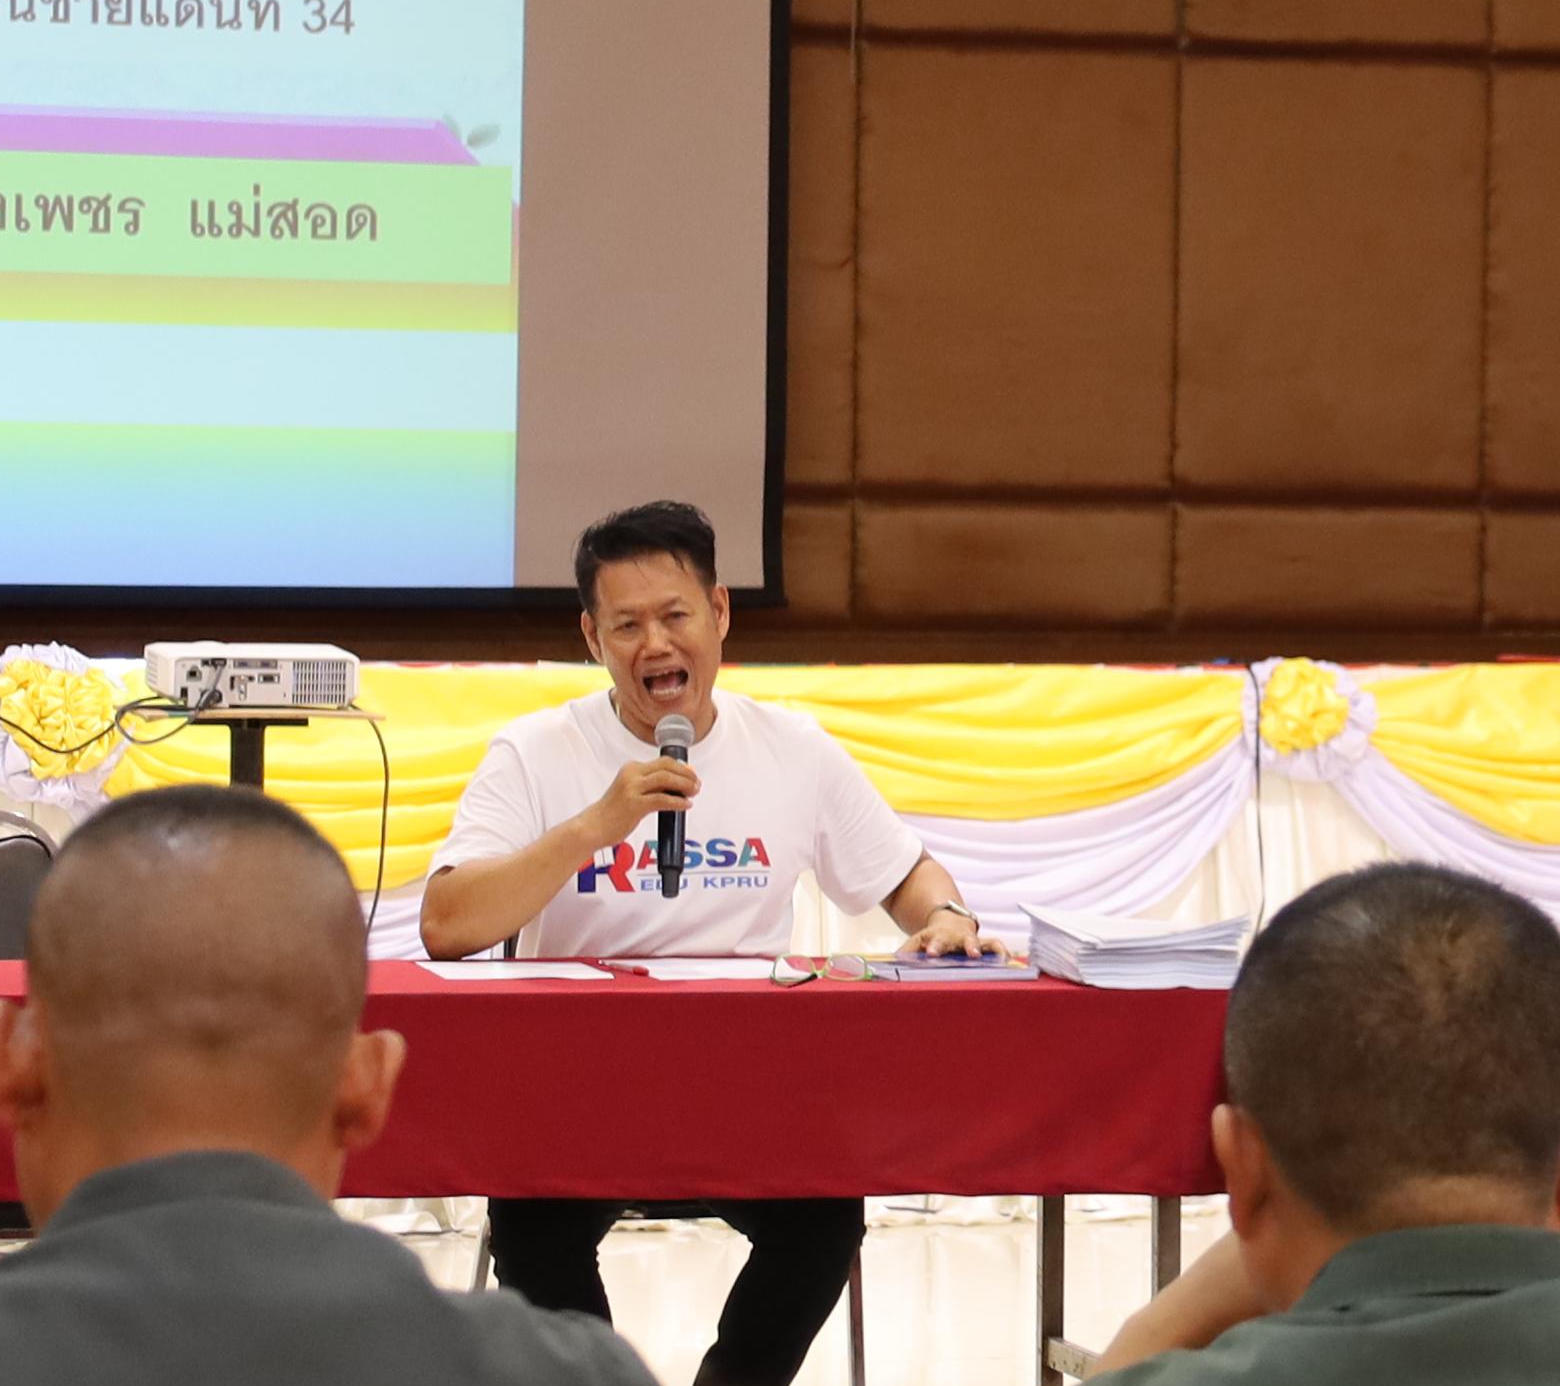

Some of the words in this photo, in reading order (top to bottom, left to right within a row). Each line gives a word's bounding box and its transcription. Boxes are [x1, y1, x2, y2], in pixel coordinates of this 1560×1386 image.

[190, 183, 378, 242] แม่สอด
[703, 876, 768, 889] KPRU
